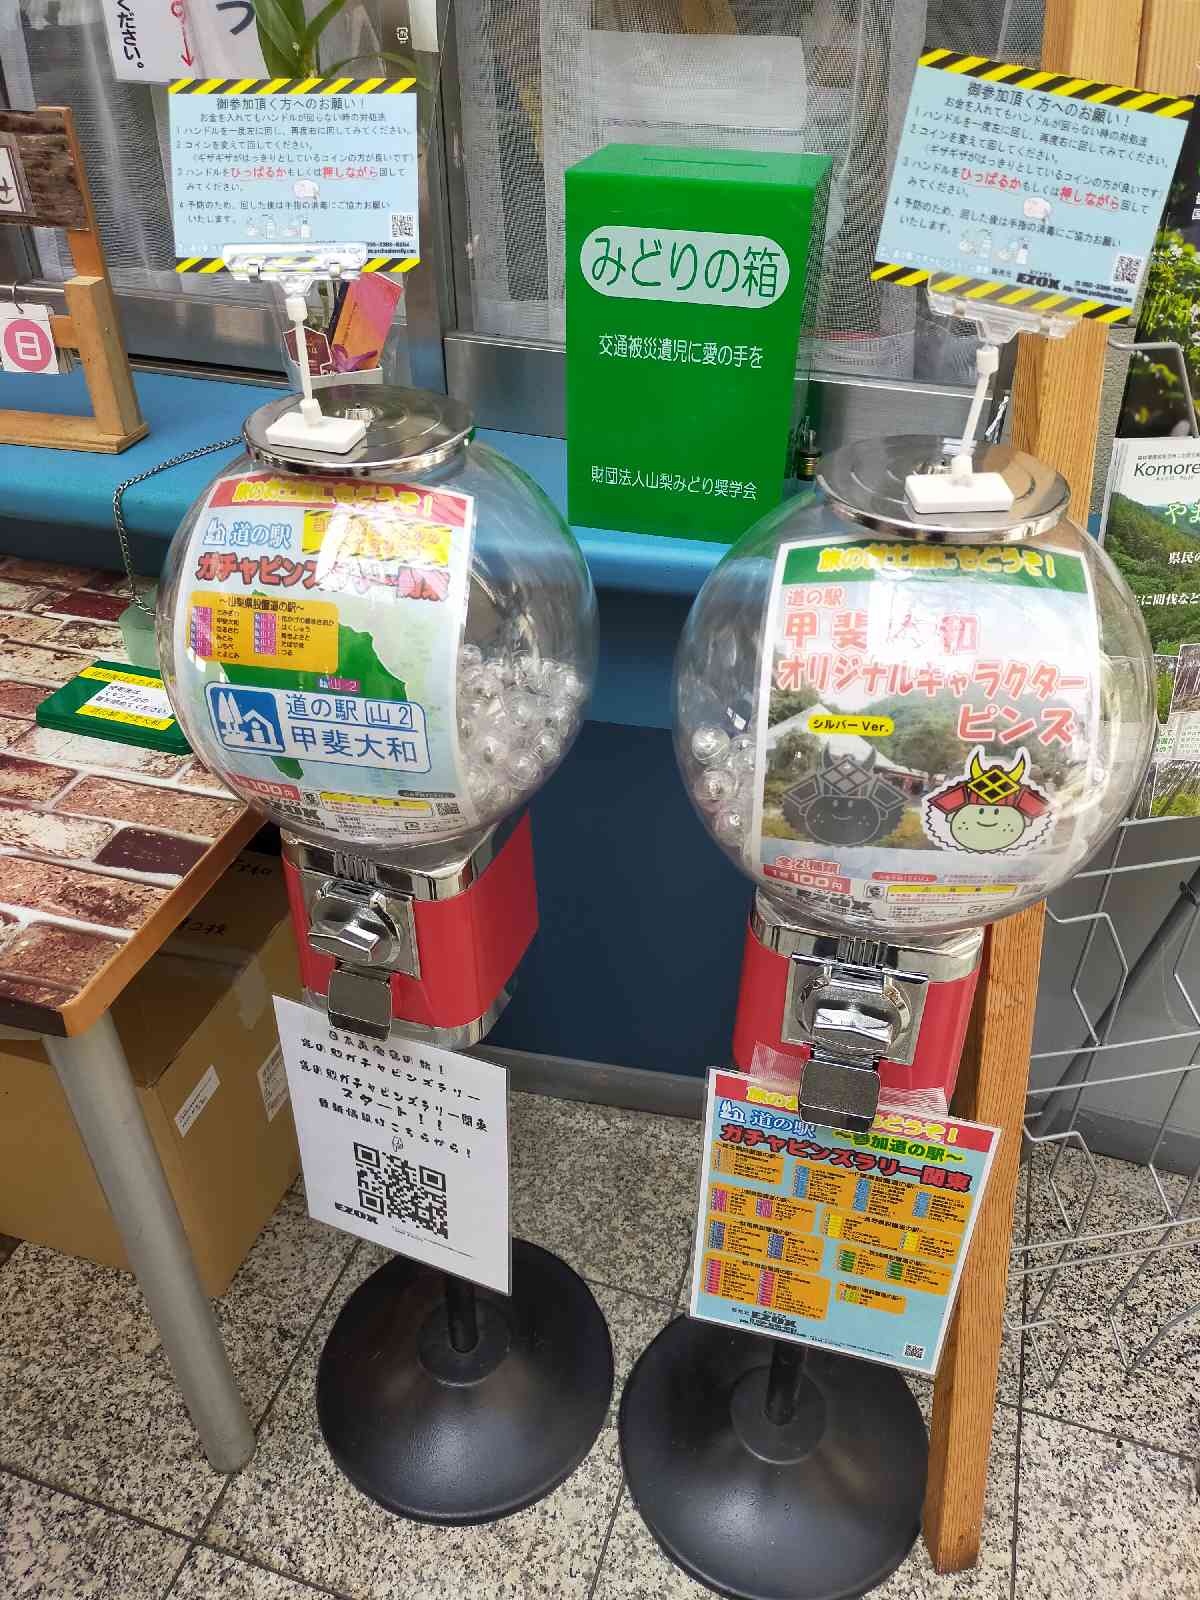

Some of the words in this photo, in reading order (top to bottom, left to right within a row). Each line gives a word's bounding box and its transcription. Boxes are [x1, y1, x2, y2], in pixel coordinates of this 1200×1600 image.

[591, 237, 781, 298] みどりの箱
[15, 331, 42, 361] 日
[598, 332, 764, 369] 交通被災遺児に愛の手を
[590, 465, 758, 500] 財団法人山梨みどり奨学会
[229, 519, 293, 549] 道の駅
[785, 586, 845, 610] 道の駅
[775, 653, 1088, 700] オリジナルキャラクター
[284, 693, 358, 723] 道の駅
[813, 718, 859, 731] シルバー
[862, 720, 890, 733] Ver.
[957, 702, 1077, 746] ピンズ
[290, 725, 419, 765] 甲斐大和
[750, 1109, 817, 1138] 道の駅
[719, 1123, 973, 1193] ガチャピンズラリー関東
